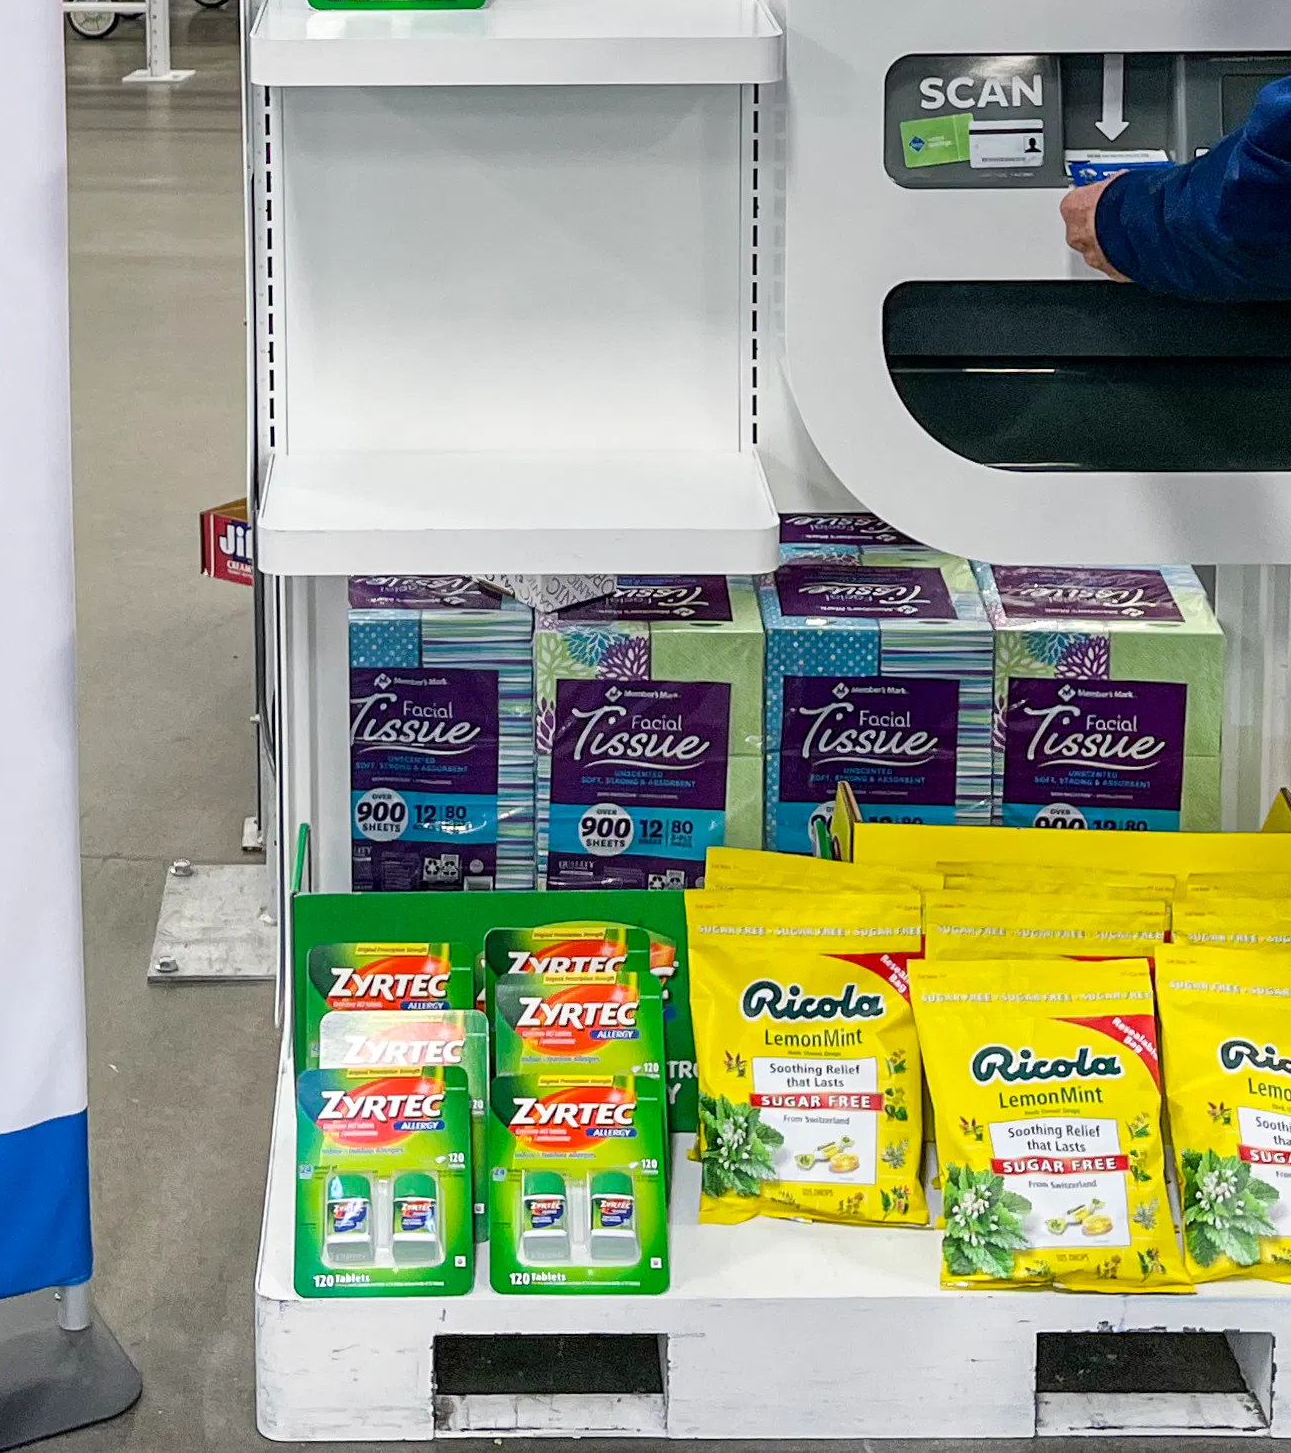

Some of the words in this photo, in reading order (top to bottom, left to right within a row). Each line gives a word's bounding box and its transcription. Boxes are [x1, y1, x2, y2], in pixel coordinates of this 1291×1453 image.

[918, 74, 1044, 110] SCAN
[571, 705, 710, 761] Tissue
[631, 715, 682, 732] Facial
[1023, 703, 1166, 761] Tissue
[1086, 714, 1139, 733] Facial
[581, 816, 631, 839] 900
[638, 819, 663, 838] 12
[671, 820, 694, 834] 80
[585, 838, 626, 848] SHEETS
[742, 979, 886, 1021] Ricola
[769, 1062, 822, 1077] Soothing
[825, 1062, 861, 1076] Relief
[786, 1076, 811, 1089] that
[814, 1076, 845, 1089] Lasts
[318, 1089, 446, 1122] ZYRTEC
[761, 1094, 821, 1109] SUGAR
[828, 1094, 872, 1109] FREE
[510, 1097, 637, 1128] ZYRTEC
[400, 1121, 441, 1130] ALLERGY
[594, 1128, 633, 1138] ALLERGY
